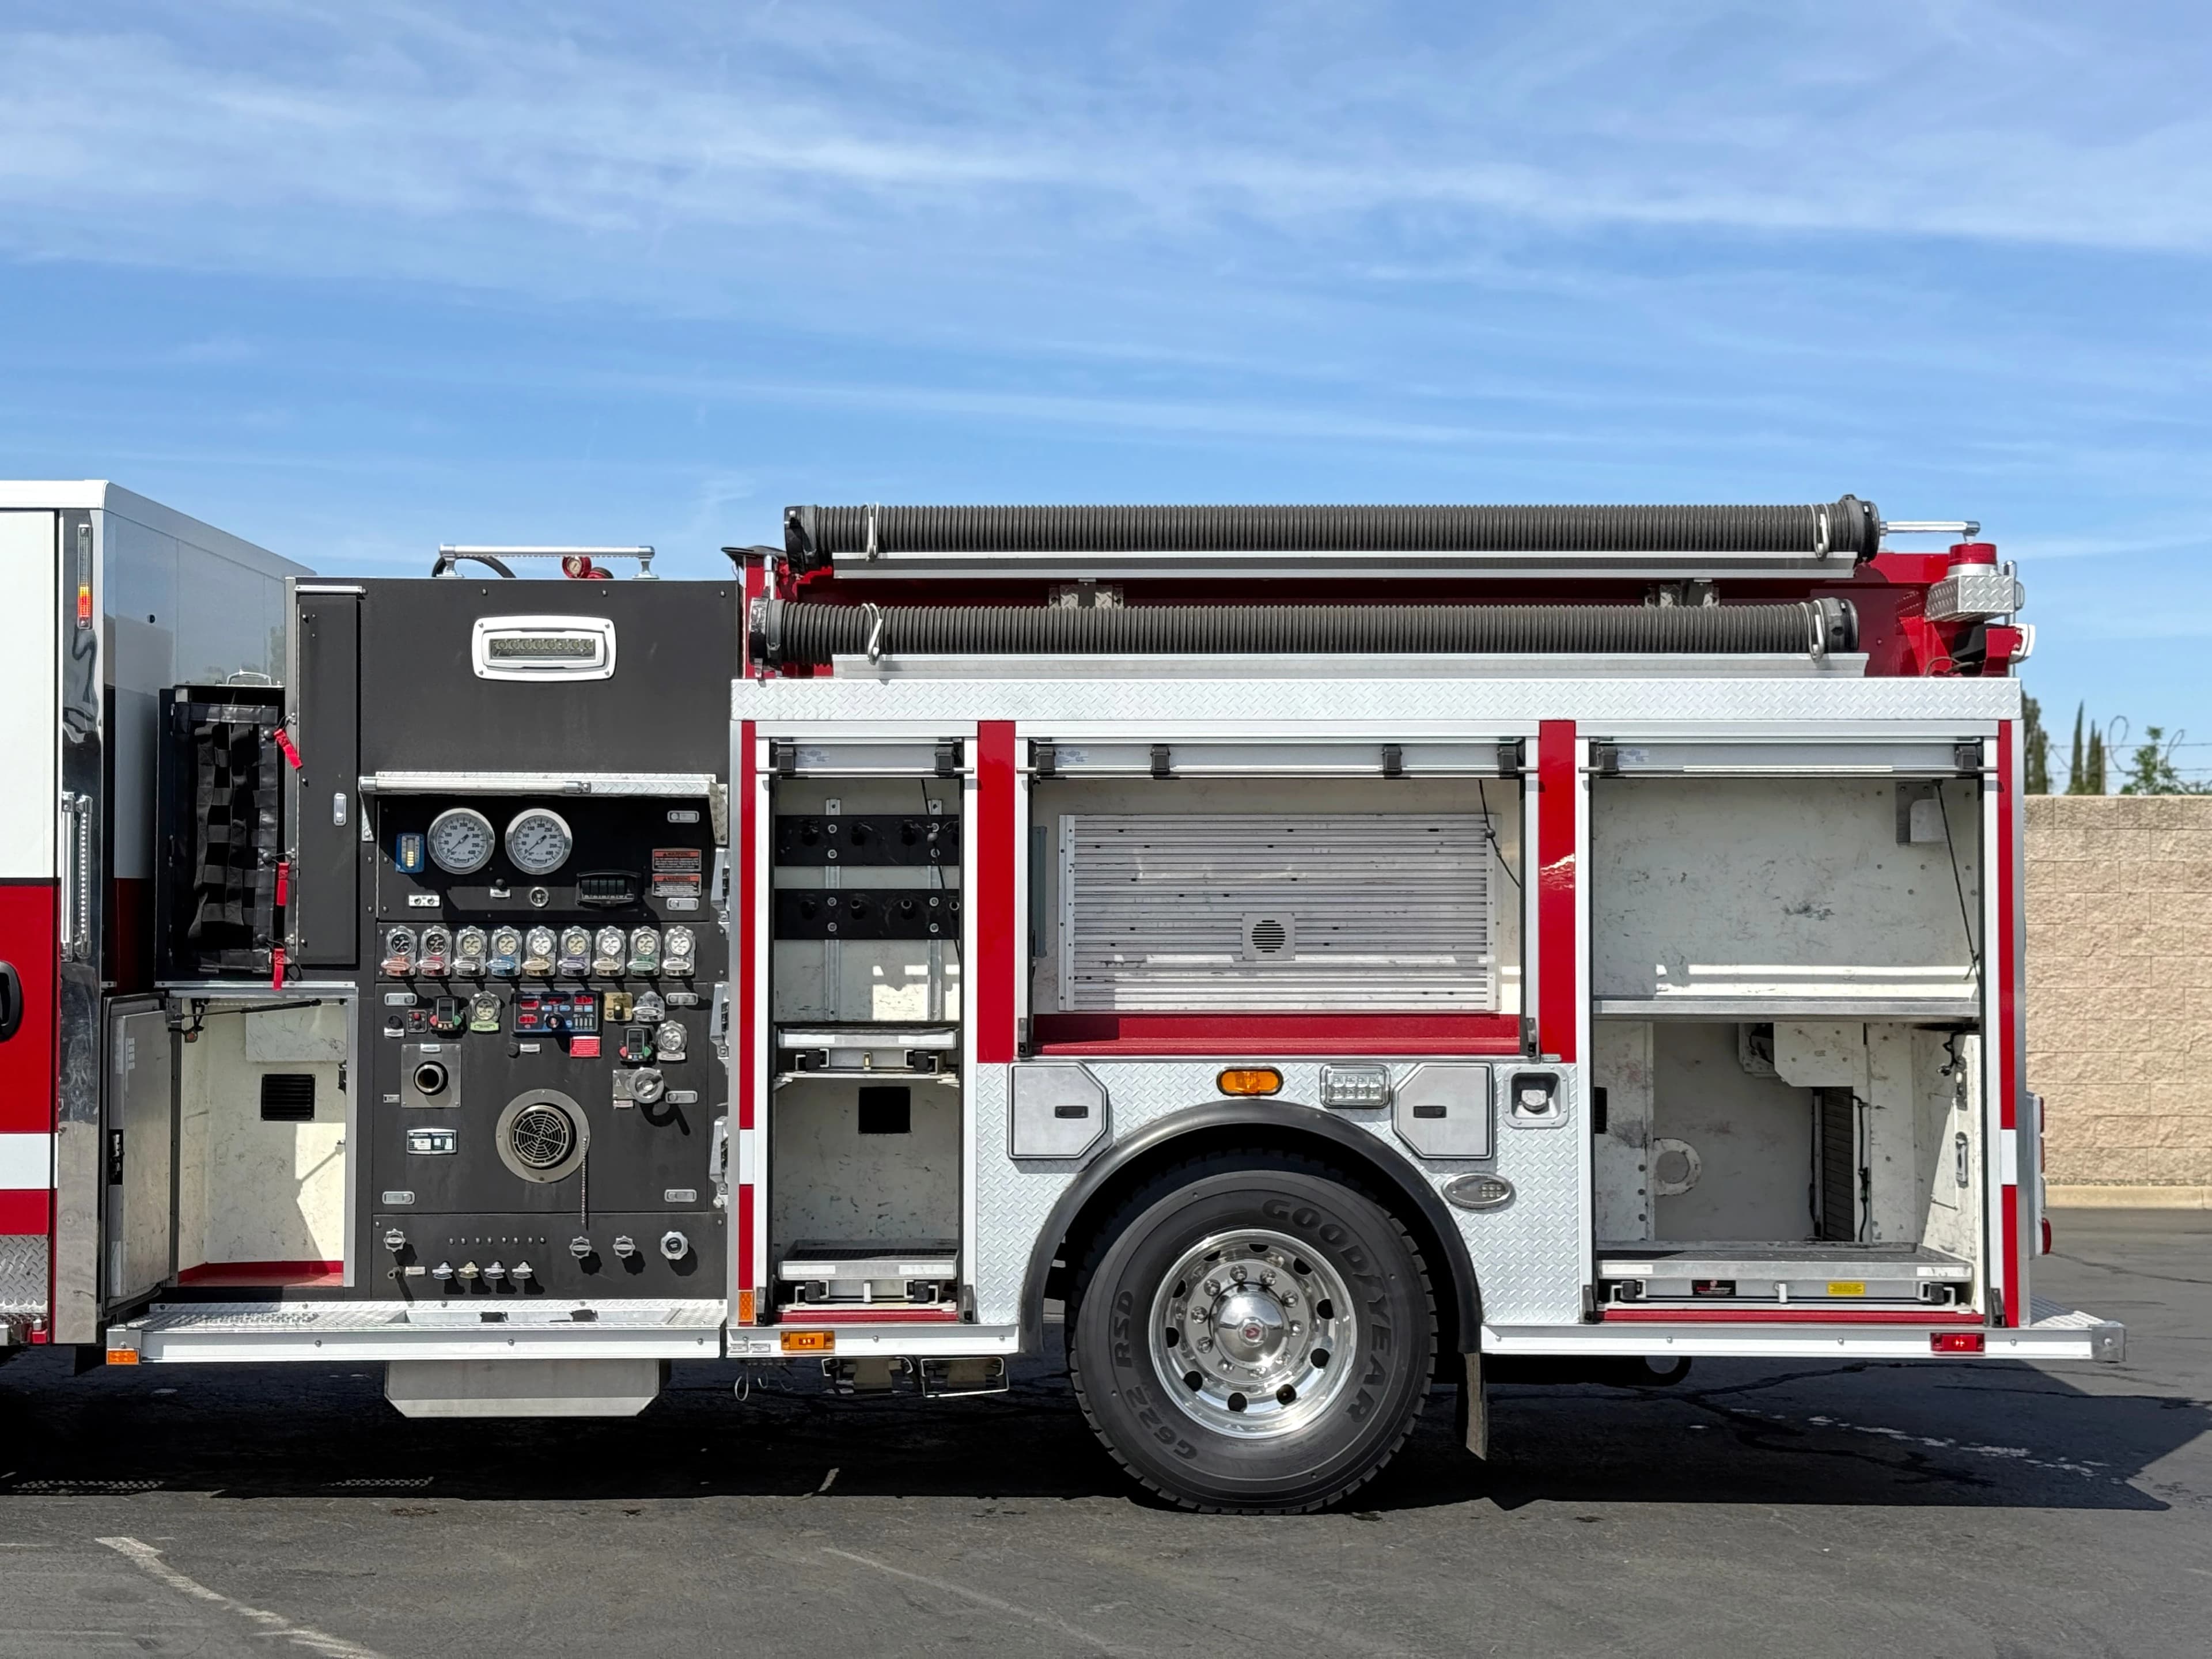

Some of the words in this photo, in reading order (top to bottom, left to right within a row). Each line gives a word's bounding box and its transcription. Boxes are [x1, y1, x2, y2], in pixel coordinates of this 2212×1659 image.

[1113, 1290, 1134, 1369] RSD
[1263, 1199, 1392, 1423] GOODYEAR
[1126, 1386, 1198, 1460] G622
